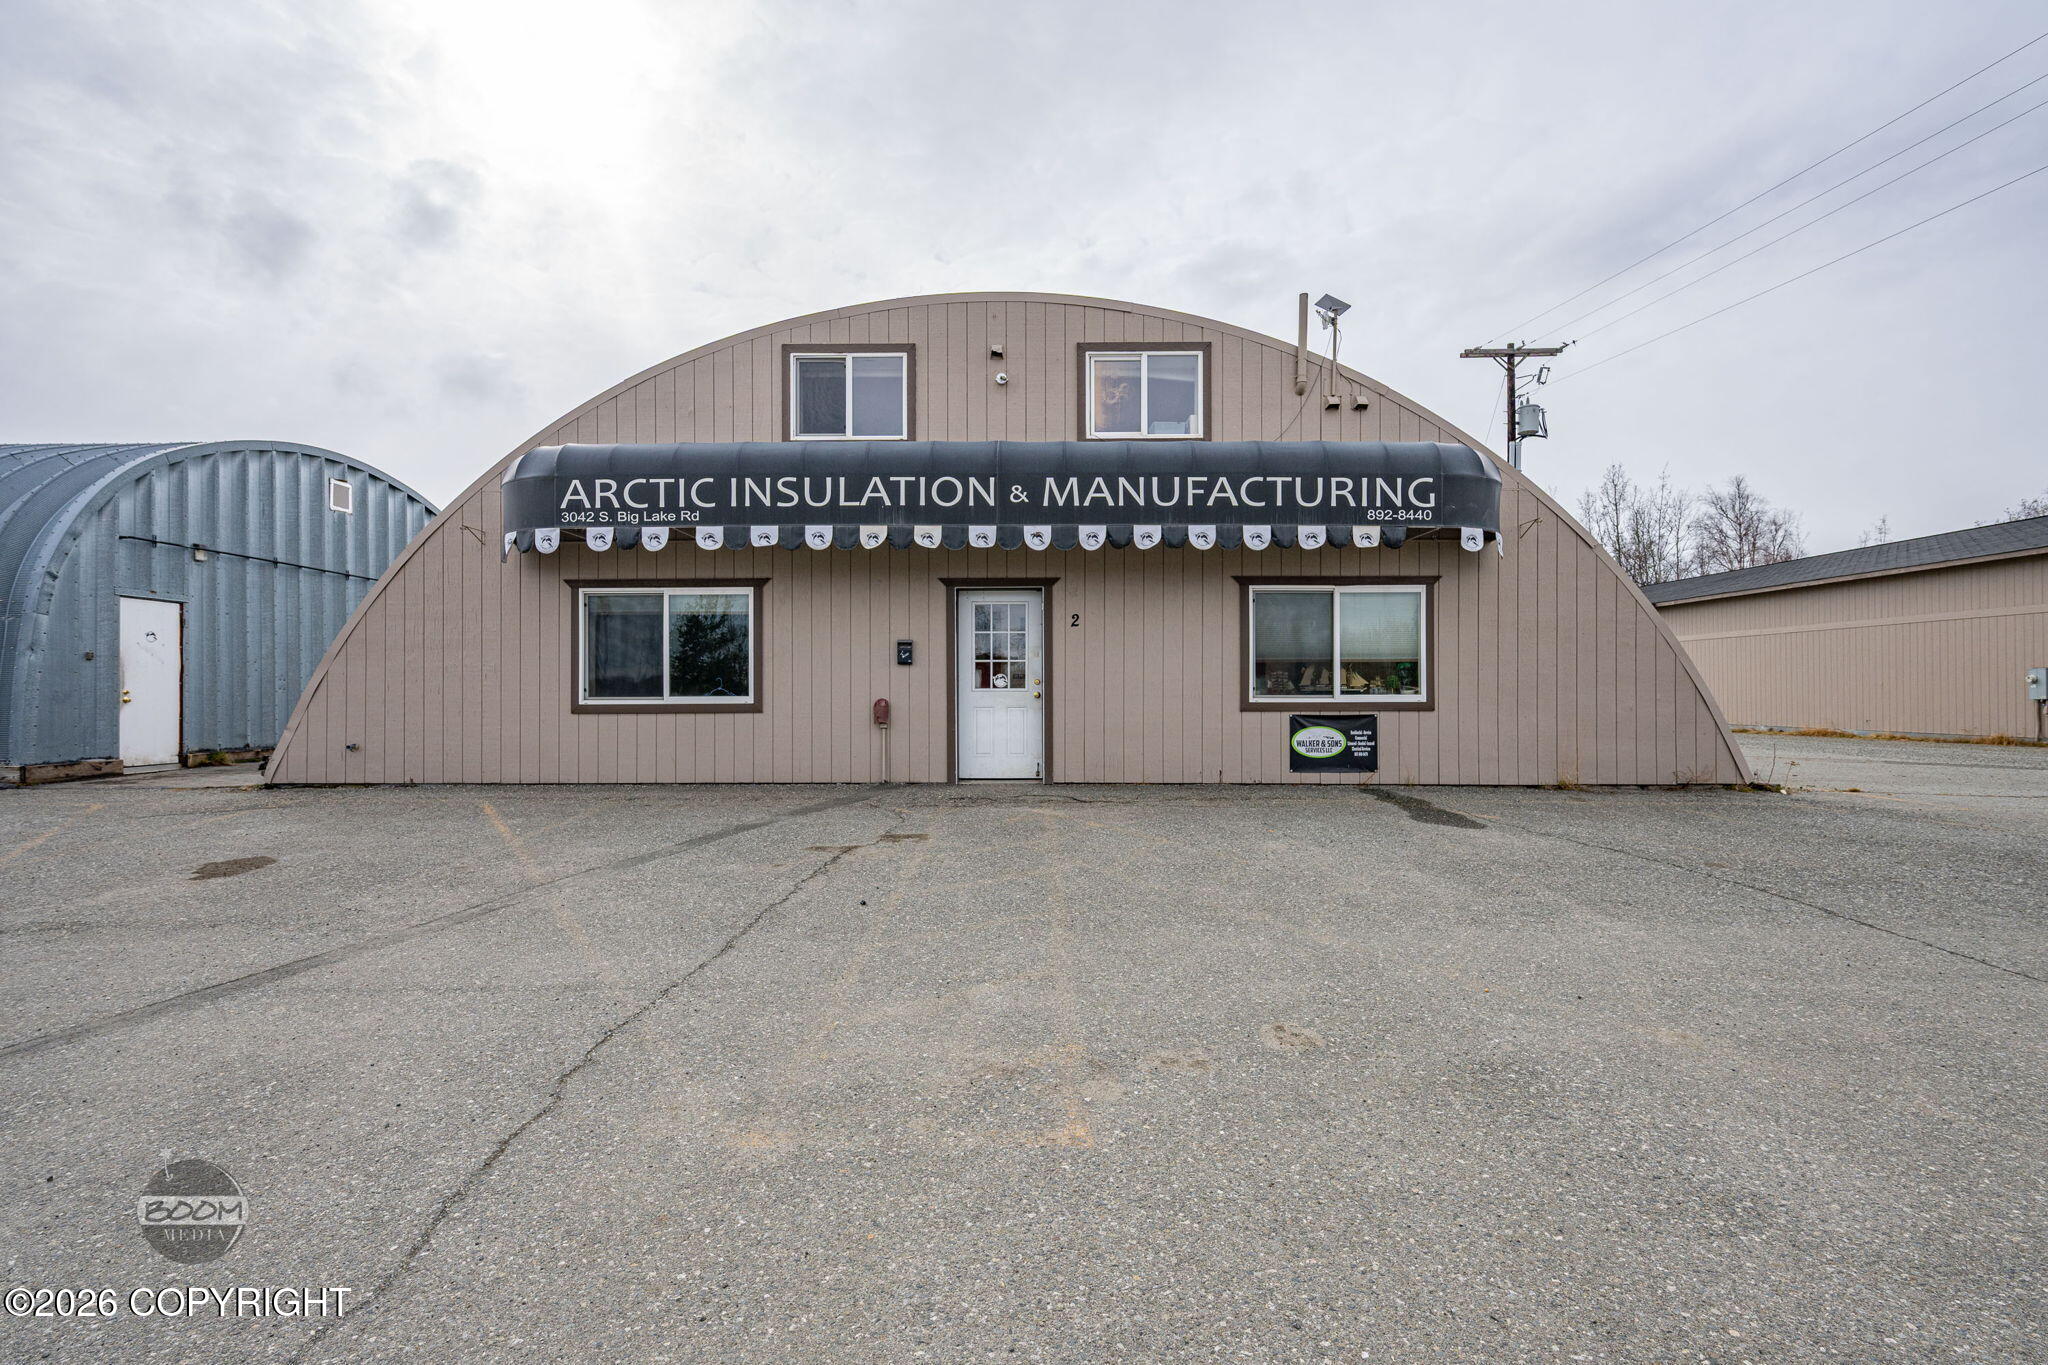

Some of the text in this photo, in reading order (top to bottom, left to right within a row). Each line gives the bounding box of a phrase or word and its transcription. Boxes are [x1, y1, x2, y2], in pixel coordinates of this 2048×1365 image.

[560, 476, 1436, 509] ARCTIC INSULATION & MANUFACTURING
[561, 510, 700, 524] 3042 S. Big Lake Rd
[1366, 509, 1432, 521] 892-8440
[1070, 614, 1080, 627] 2
[1296, 740, 1320, 748] WALKER
[1327, 740, 1342, 748] SONS
